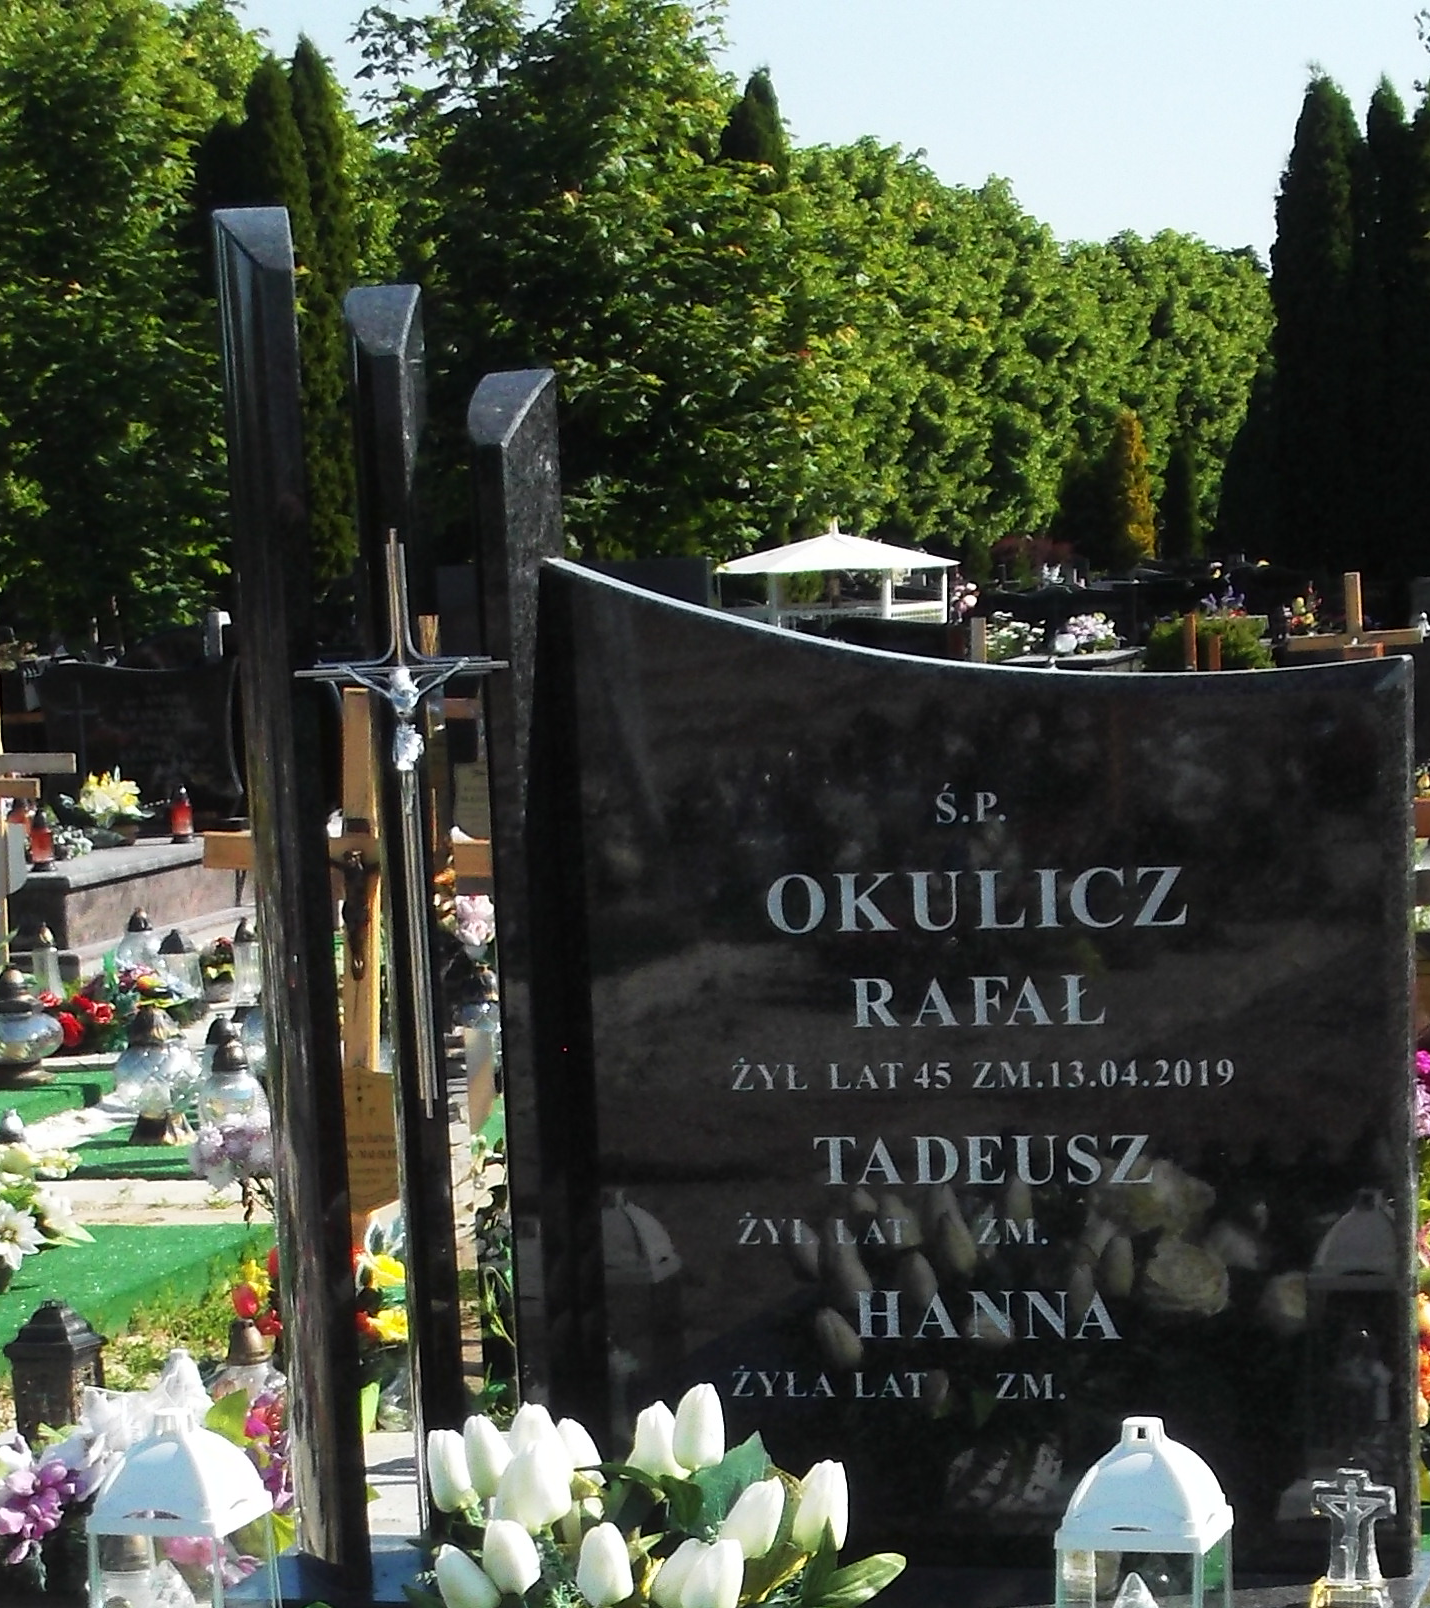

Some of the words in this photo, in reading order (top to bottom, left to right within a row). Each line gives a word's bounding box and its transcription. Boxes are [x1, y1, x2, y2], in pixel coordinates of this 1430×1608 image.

[934, 782, 1008, 824] Ś.P.
[765, 865, 1189, 934] OKULICZ
[851, 974, 1107, 1029] RAFAŁ
[732, 1056, 809, 1093] ŻYŁ
[829, 1062, 903, 1092] LAT
[913, 1060, 953, 1091] 45
[972, 1058, 1236, 1091] ZM.13.04.2019
[813, 1134, 1155, 1188] TADEUSZ
[835, 1217, 909, 1247] LAT
[977, 1214, 1049, 1247] ZM.
[856, 1289, 1123, 1341] HANNA
[732, 1365, 836, 1400] ŻYŁA
[855, 1371, 928, 1400] LAT
[996, 1372, 1067, 1400] ZM.
